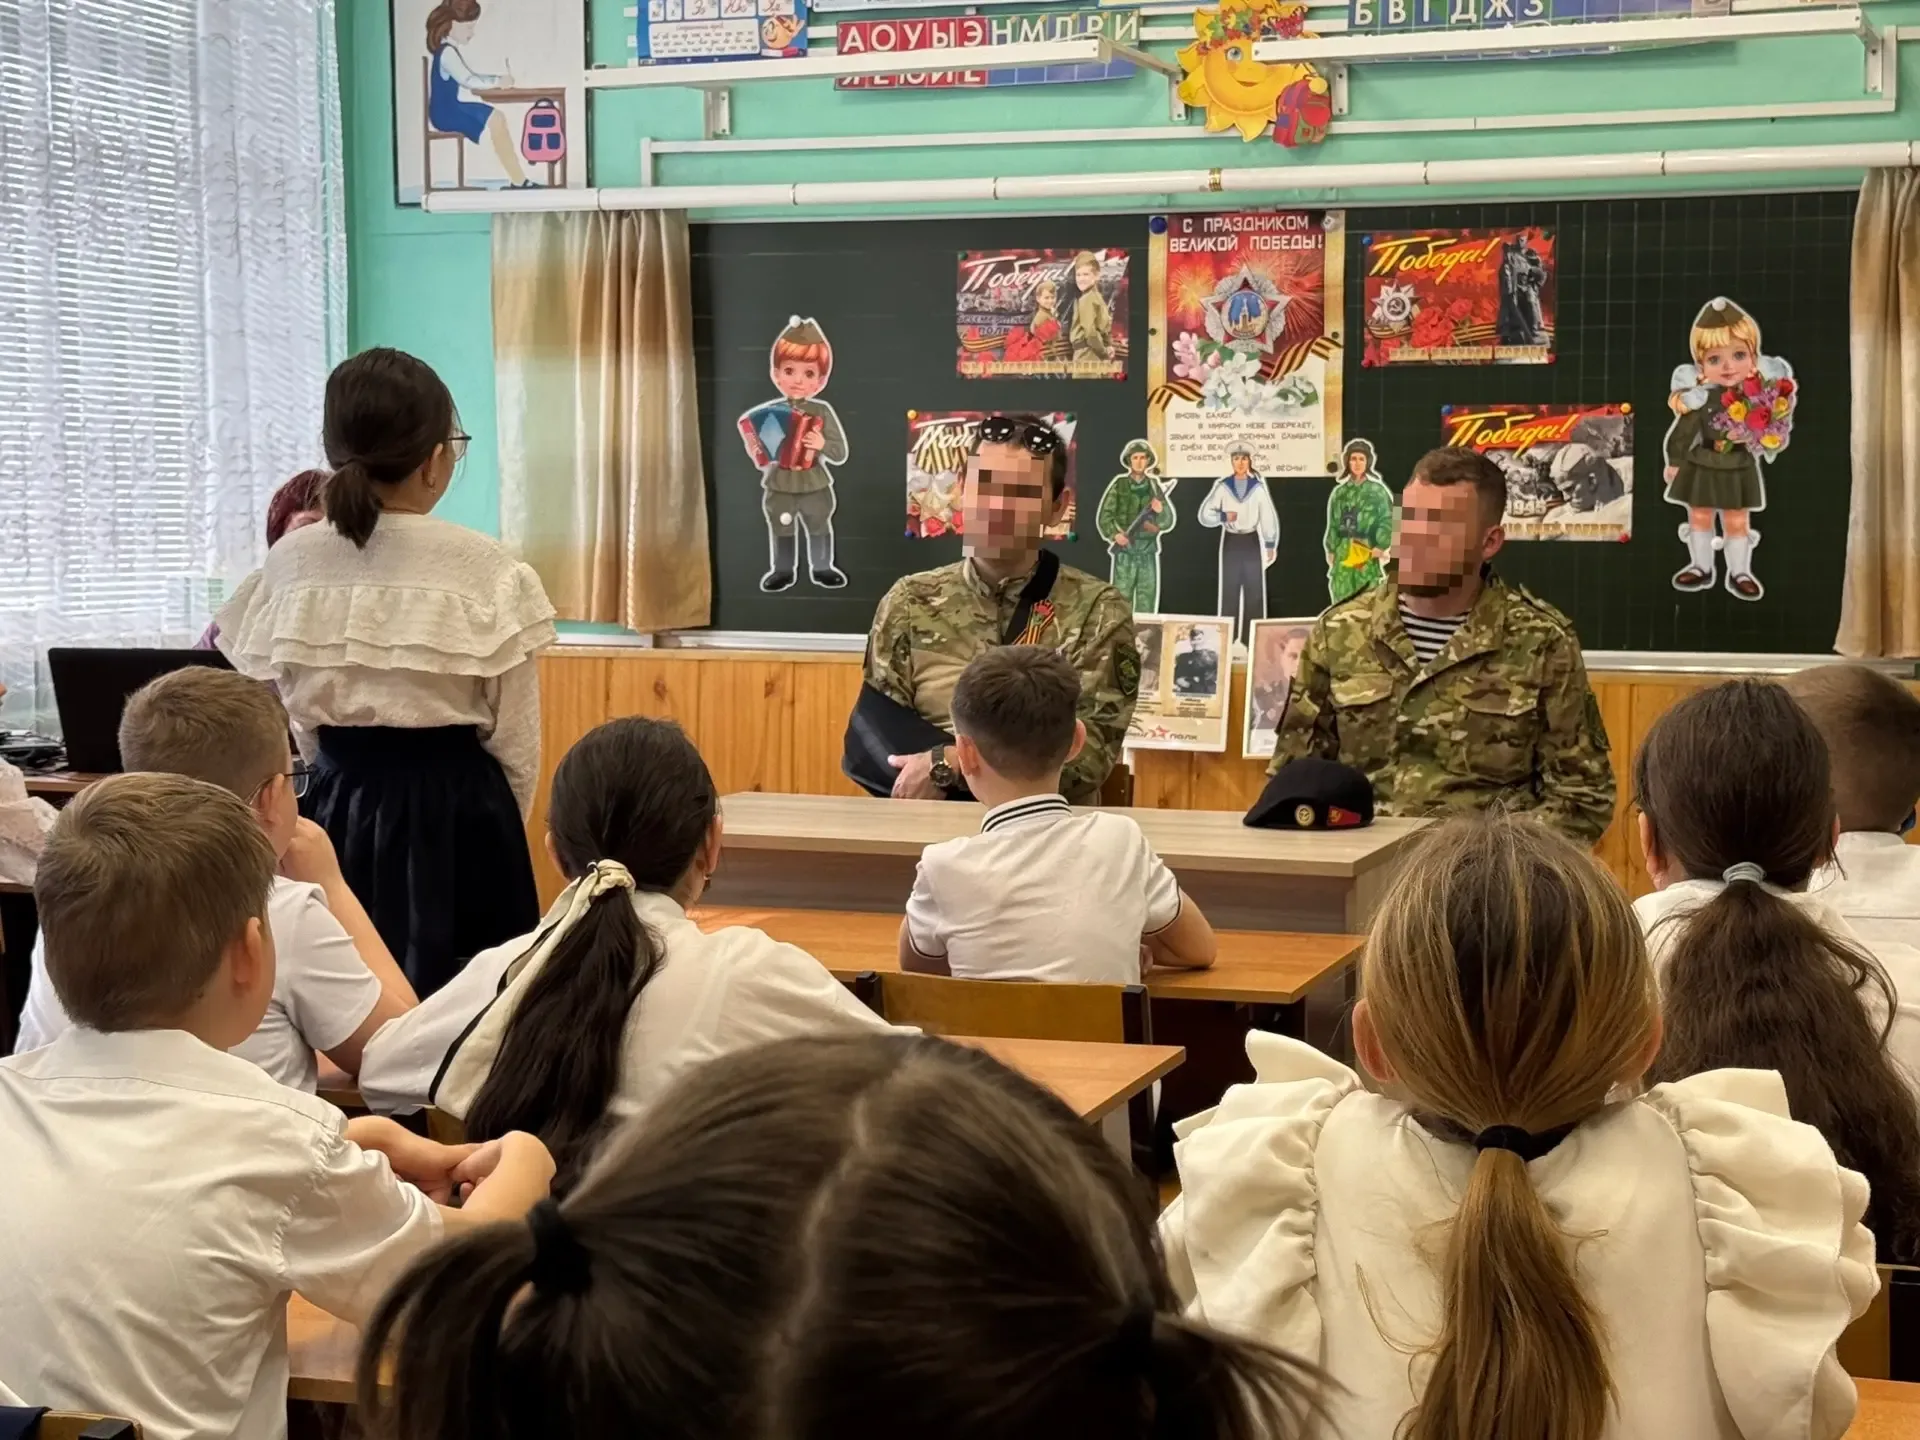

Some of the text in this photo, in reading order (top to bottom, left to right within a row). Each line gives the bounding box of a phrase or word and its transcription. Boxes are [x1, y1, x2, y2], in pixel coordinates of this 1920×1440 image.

[1169, 234, 1324, 253] ВЕЛИКОЙ ПОБЕДЫ!
[1182, 215, 1309, 233] С ПРАЗДНИКОМ
[960, 255, 1076, 301] Победа!
[1368, 235, 1501, 286] Победа!
[1447, 410, 1580, 460] Победа!
